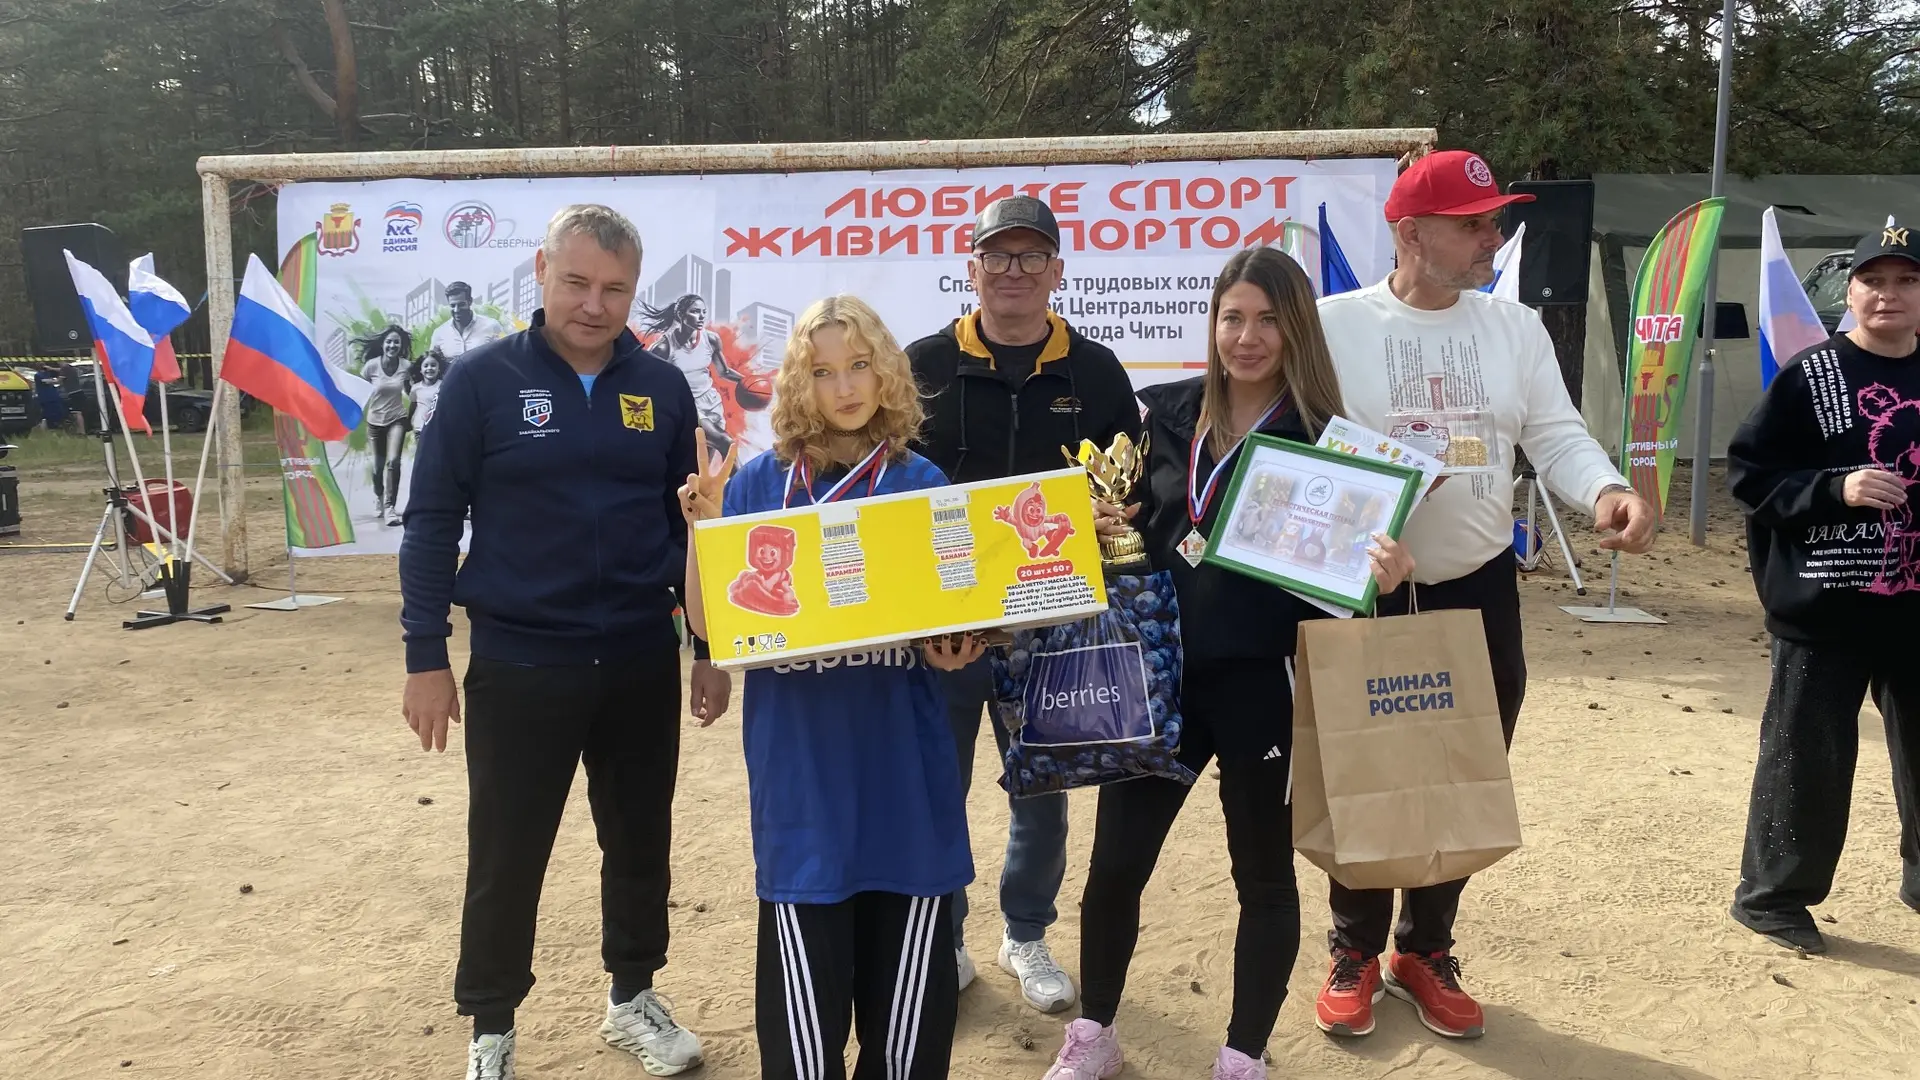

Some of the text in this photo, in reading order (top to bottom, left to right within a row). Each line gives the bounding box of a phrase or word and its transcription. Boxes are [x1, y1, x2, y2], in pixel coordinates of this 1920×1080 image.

[1109, 176, 1298, 211] СПОРТ
[383, 237, 418, 245] ЕДИНАЯ
[488, 237, 545, 248] СЕВЕРНЫЙ
[1057, 216, 1291, 251] ПОРТОМ
[383, 244, 418, 252] РОССИЯ
[1073, 277, 1172, 294] трудовых
[961, 303, 971, 315] и
[1070, 297, 1209, 318] Центрального
[1130, 322, 1183, 340] Читы
[1636, 316, 1683, 342] ЧИТА
[527, 404, 548, 418] ГТО
[1366, 672, 1451, 696] ЕДИНАЯ
[1042, 682, 1120, 710] berries
[1370, 692, 1454, 716] РОССИЯ
